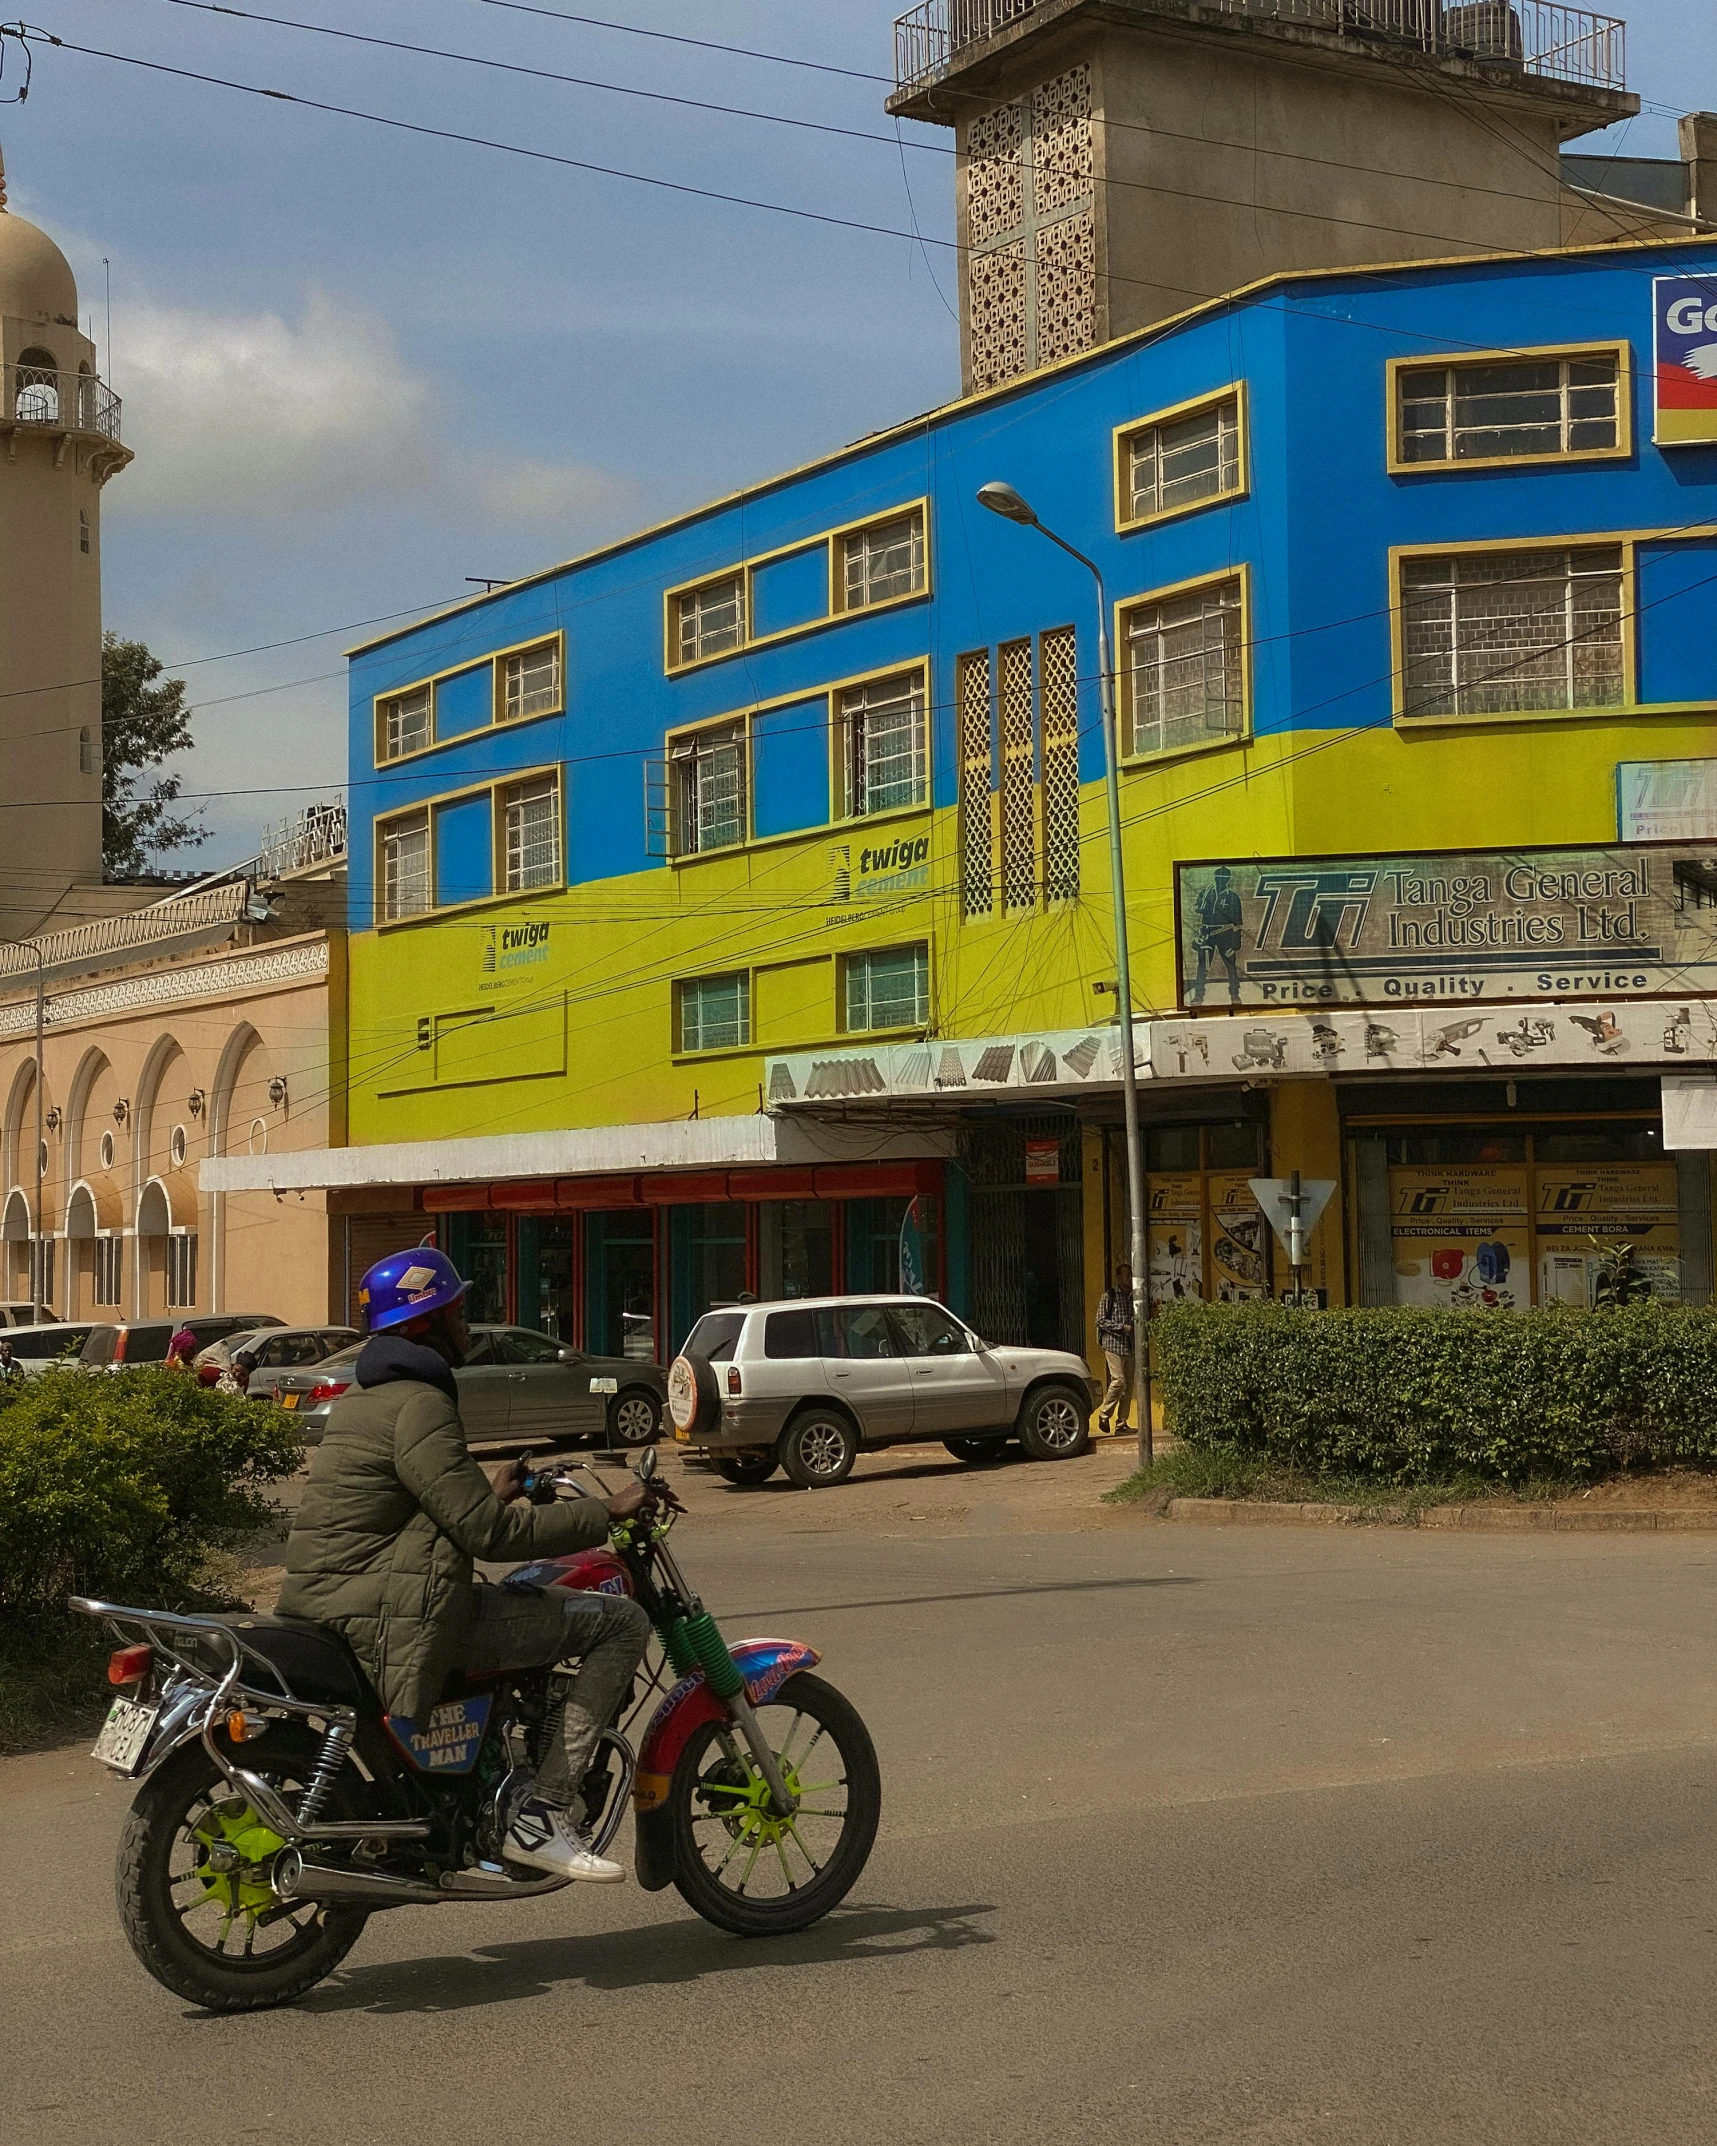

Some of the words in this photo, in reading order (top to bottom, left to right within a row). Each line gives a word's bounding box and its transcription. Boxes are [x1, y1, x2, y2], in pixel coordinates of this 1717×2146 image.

[860, 837, 930, 874] twiga
[857, 866, 929, 897] cement
[1383, 867, 1492, 918] Tanga
[1505, 857, 1650, 901] General
[502, 922, 549, 950] twiga
[1388, 907, 1565, 951] Industries
[1576, 901, 1651, 944] Ltd.
[500, 944, 549, 969] cement
[1262, 980, 1333, 999] Price
[1383, 976, 1485, 997] Quality
[1537, 971, 1648, 991] Service
[1453, 1187, 1481, 1196] Tanga
[1483, 1187, 1521, 1195] General
[1600, 1184, 1624, 1193] Tanga
[1626, 1184, 1659, 1192] General
[1453, 1199, 1500, 1208] Industries
[1502, 1199, 1519, 1208] Ltd
[1436, 1217, 1464, 1225] Quality
[1590, 1215, 1618, 1223] Quality
[1393, 1228, 1461, 1236] ELECTRONICAL
[428, 1704, 466, 1728] THE
[410, 1721, 480, 1751] TRAVELLER
[429, 1744, 467, 1767] MAN
